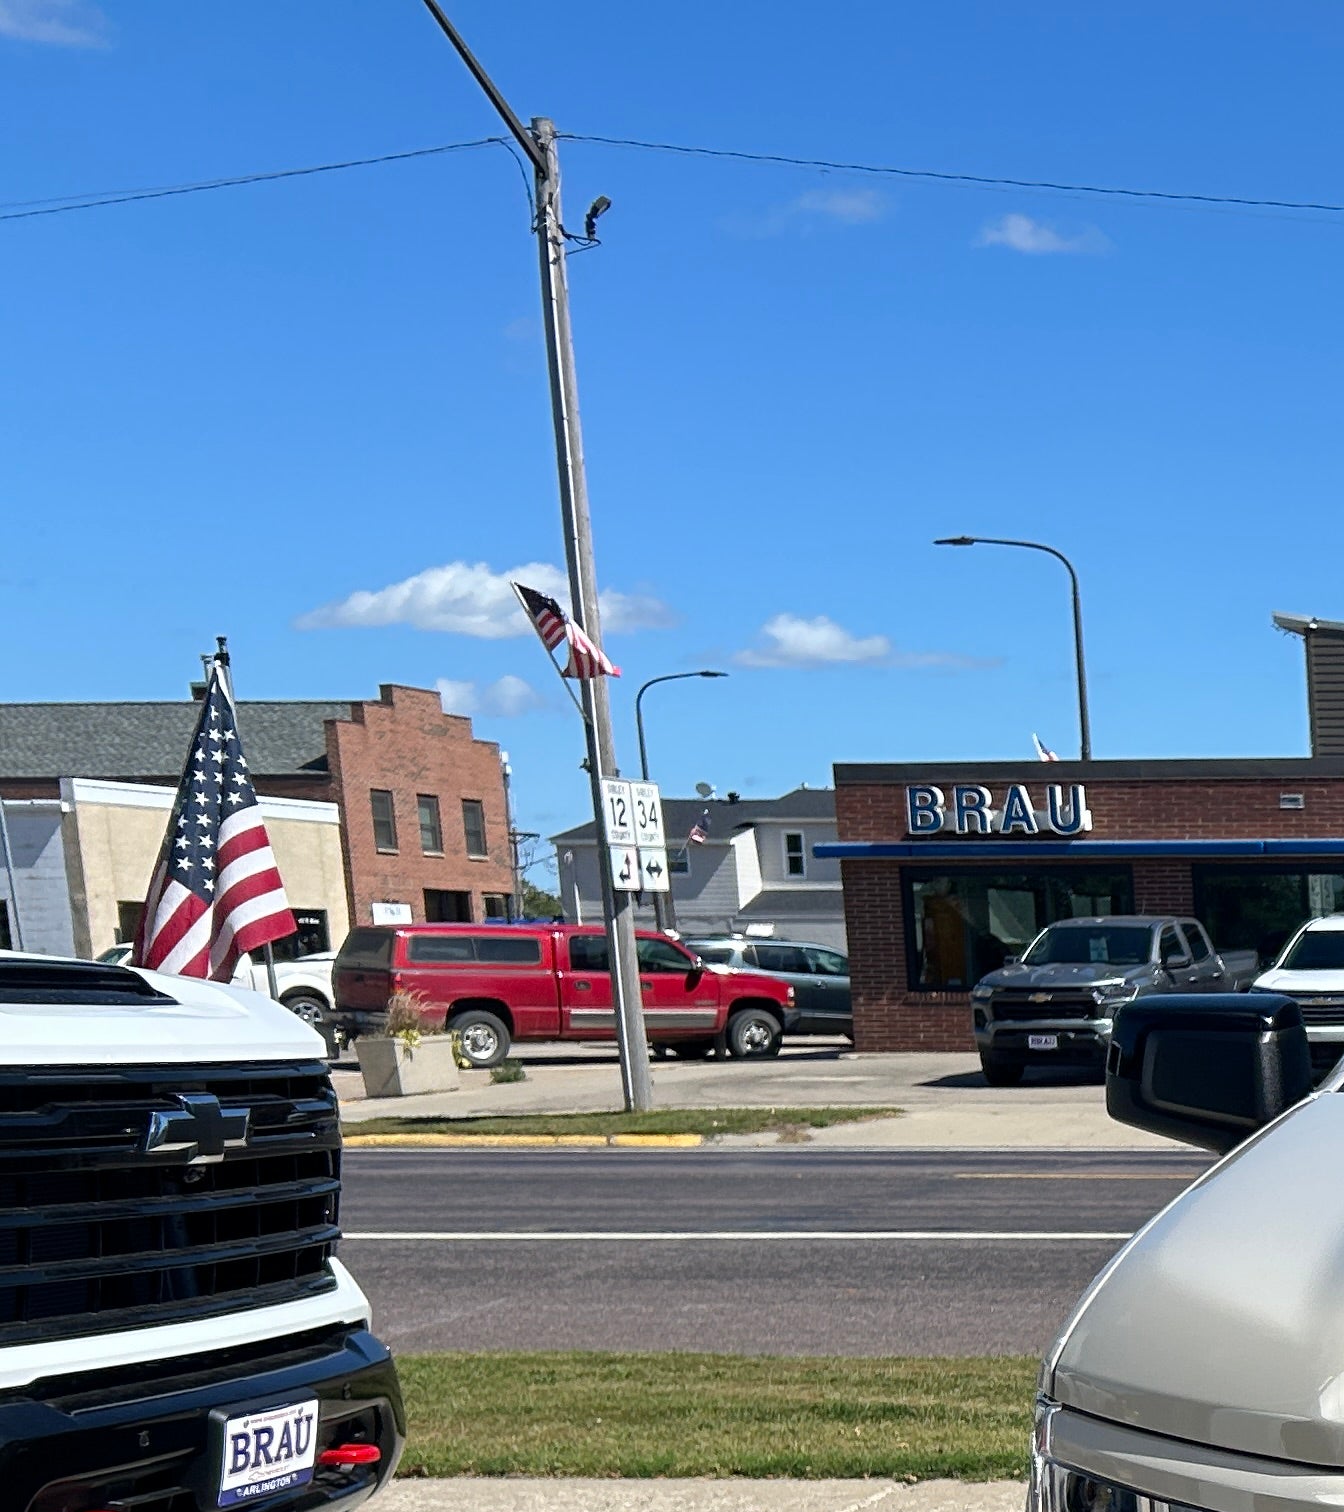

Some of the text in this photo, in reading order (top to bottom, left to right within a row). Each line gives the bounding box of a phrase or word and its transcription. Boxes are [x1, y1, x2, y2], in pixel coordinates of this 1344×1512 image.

[610, 797, 627, 827] 12
[637, 800, 658, 829] 34
[906, 784, 1088, 835] BRAU
[228, 1414, 313, 1478] BRAU
[242, 1474, 292, 1496] ARLINGTON
